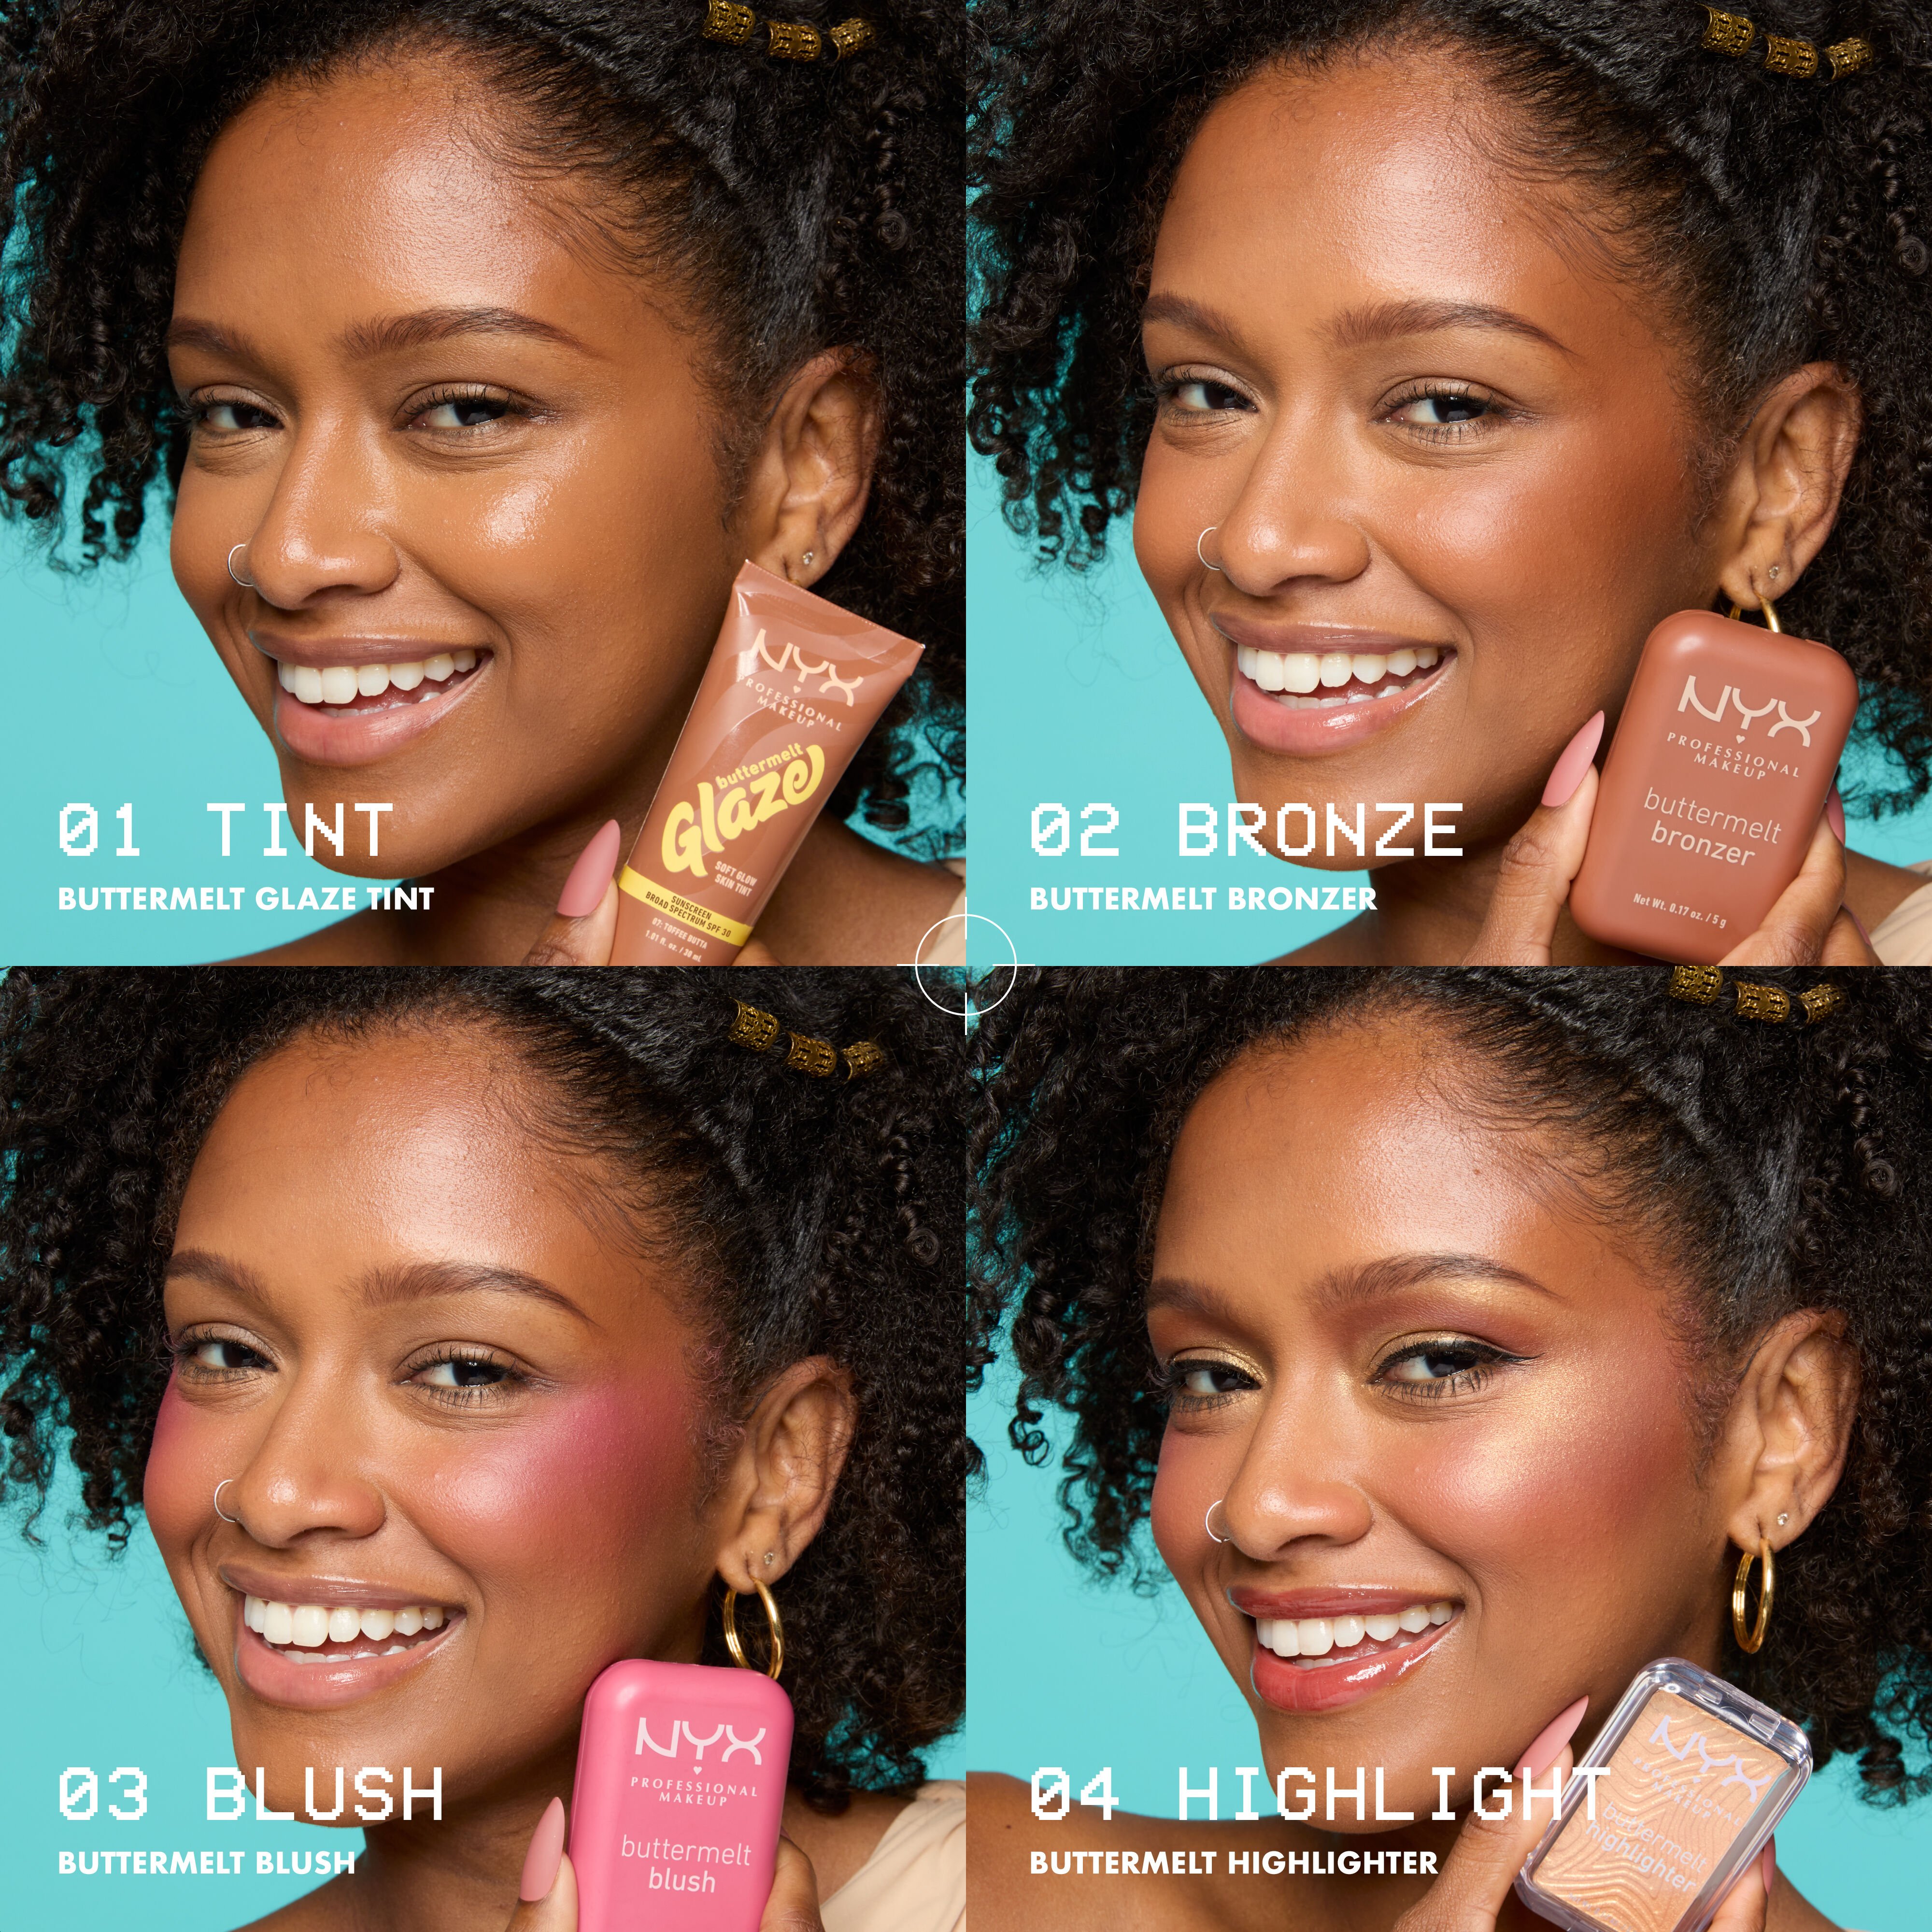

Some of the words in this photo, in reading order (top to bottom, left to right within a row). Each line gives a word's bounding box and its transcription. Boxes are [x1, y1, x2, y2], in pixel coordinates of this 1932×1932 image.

[750, 628, 864, 707] NYX
[736, 674, 842, 732] PROFESSIONAL
[757, 696, 815, 728] MAKEUP
[1677, 675, 1821, 748] NYX
[715, 743, 804, 789] buttermelt
[1667, 732, 1800, 778] PROFESSIONAL
[1694, 752, 1766, 781] MAKEUP
[662, 744, 825, 877] Glaze
[1643, 787, 1782, 844] buttermelt
[1650, 820, 1756, 867] bronzer
[715, 861, 737, 877] SOFT
[736, 871, 757, 886] GLOW
[715, 874, 735, 889] SKIN
[735, 883, 753, 897] TINT
[645, 891, 668, 909] BROAD
[669, 905, 707, 928] SPECTRUM
[707, 923, 721, 934] SPF
[722, 928, 732, 938] 30
[671, 895, 712, 920] SUNSCREEN
[1633, 893, 1650, 906] Net
[1652, 898, 1666, 911] Wt.
[1669, 903, 1690, 916] 0.17
[1690, 910, 1703, 921] oz.
[1705, 913, 1712, 922] /
[1712, 914, 1719, 924] 5
[1719, 919, 1727, 929] g
[645, 929, 659, 942] 1.01
[668, 943, 678, 952] oz.
[683, 949, 693, 958] 30
[692, 953, 702, 963] mL
[652, 917, 663, 928] 07:
[663, 922, 688, 940] TOFFEE
[687, 934, 708, 950] BUTTA
[635, 1717, 766, 1765] NYX
[1649, 1715, 1772, 1803] NYX
[631, 1776, 757, 1797] PROFESSIONAL
[659, 1792, 727, 1806] MAKEUP
[1633, 1757, 1742, 1826] PROFESSIONAL
[1651, 1780, 1711, 1818] MAKEUP
[621, 1834, 752, 1866] buttermelt
[1586, 1819, 1696, 1892] highlighter
[1602, 1801, 1707, 1873] buttermelt
[649, 1866, 716, 1893] blush
